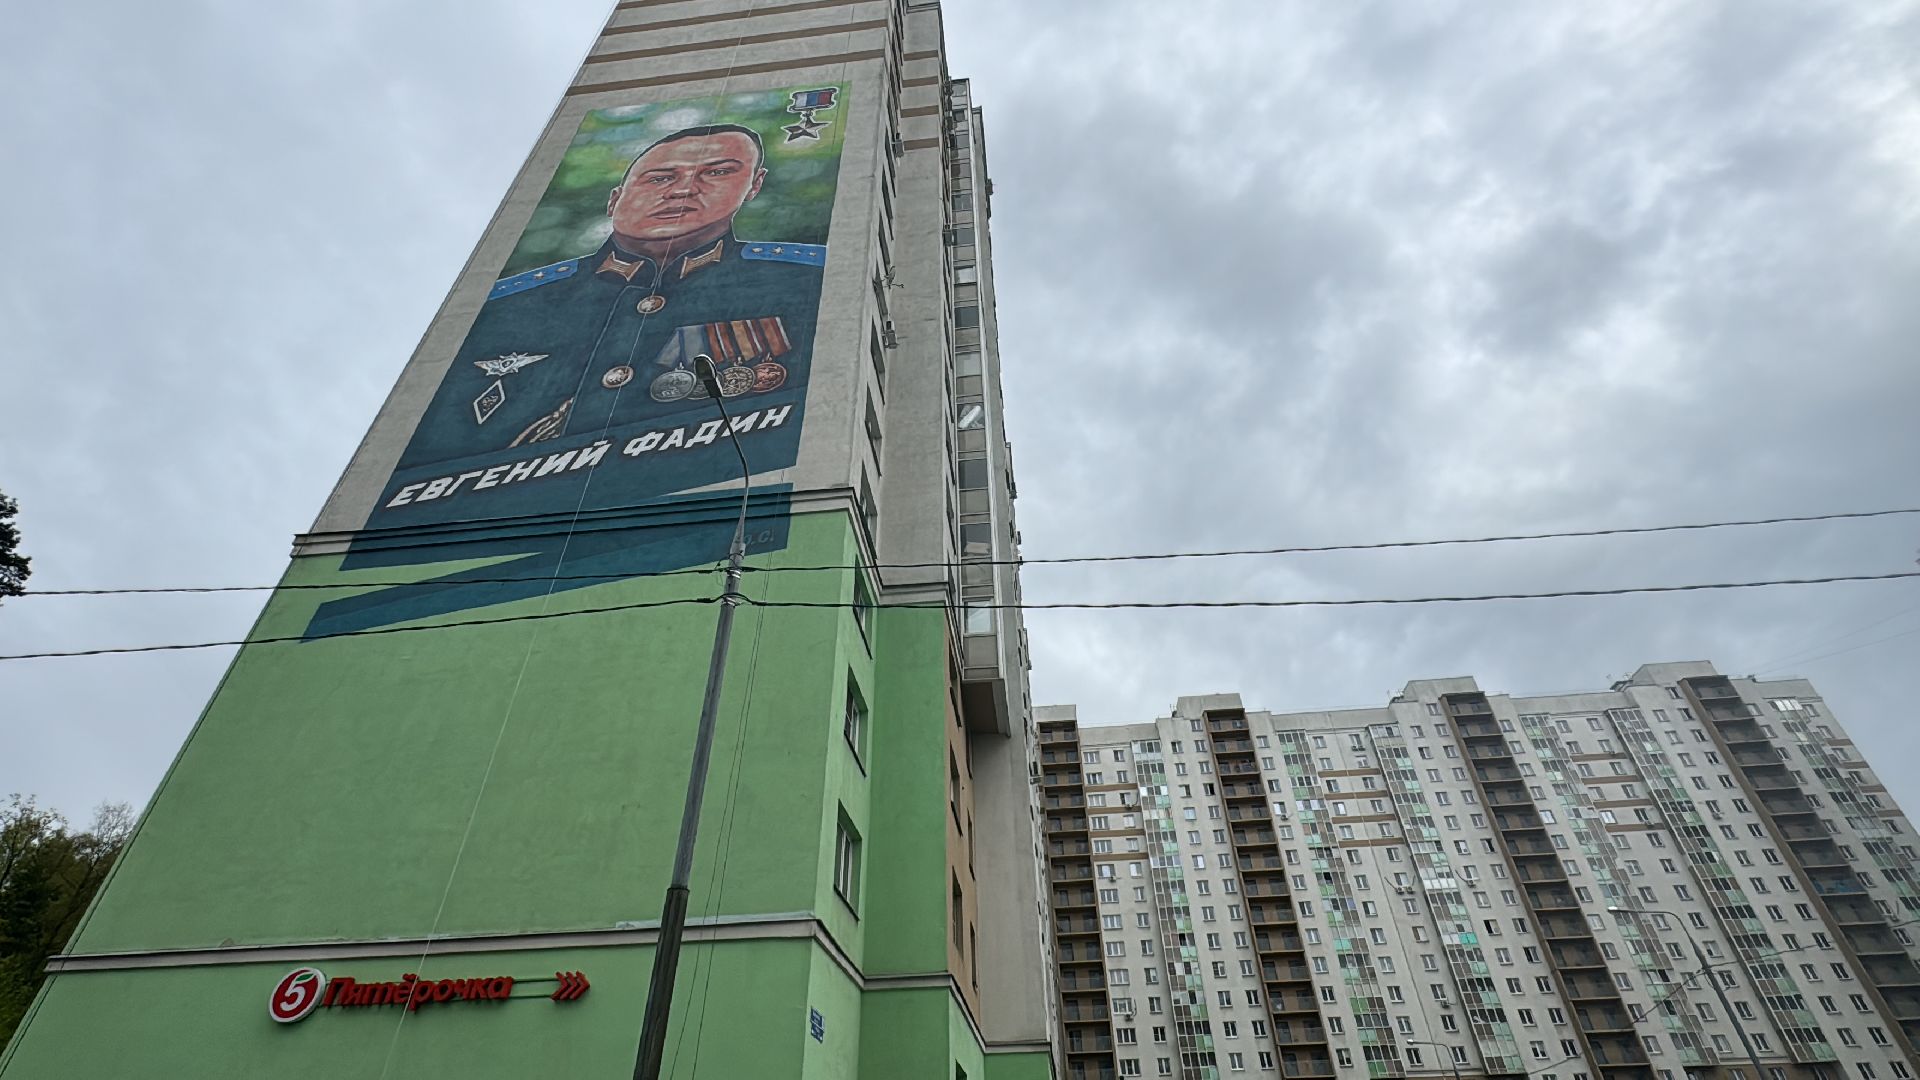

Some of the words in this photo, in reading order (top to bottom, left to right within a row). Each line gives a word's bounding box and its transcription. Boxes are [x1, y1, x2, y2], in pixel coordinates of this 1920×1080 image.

[385, 440, 613, 508] ЕВГЕНИЙ
[623, 404, 793, 457] ФАДИН
[322, 973, 514, 1013] Пятёрочка
